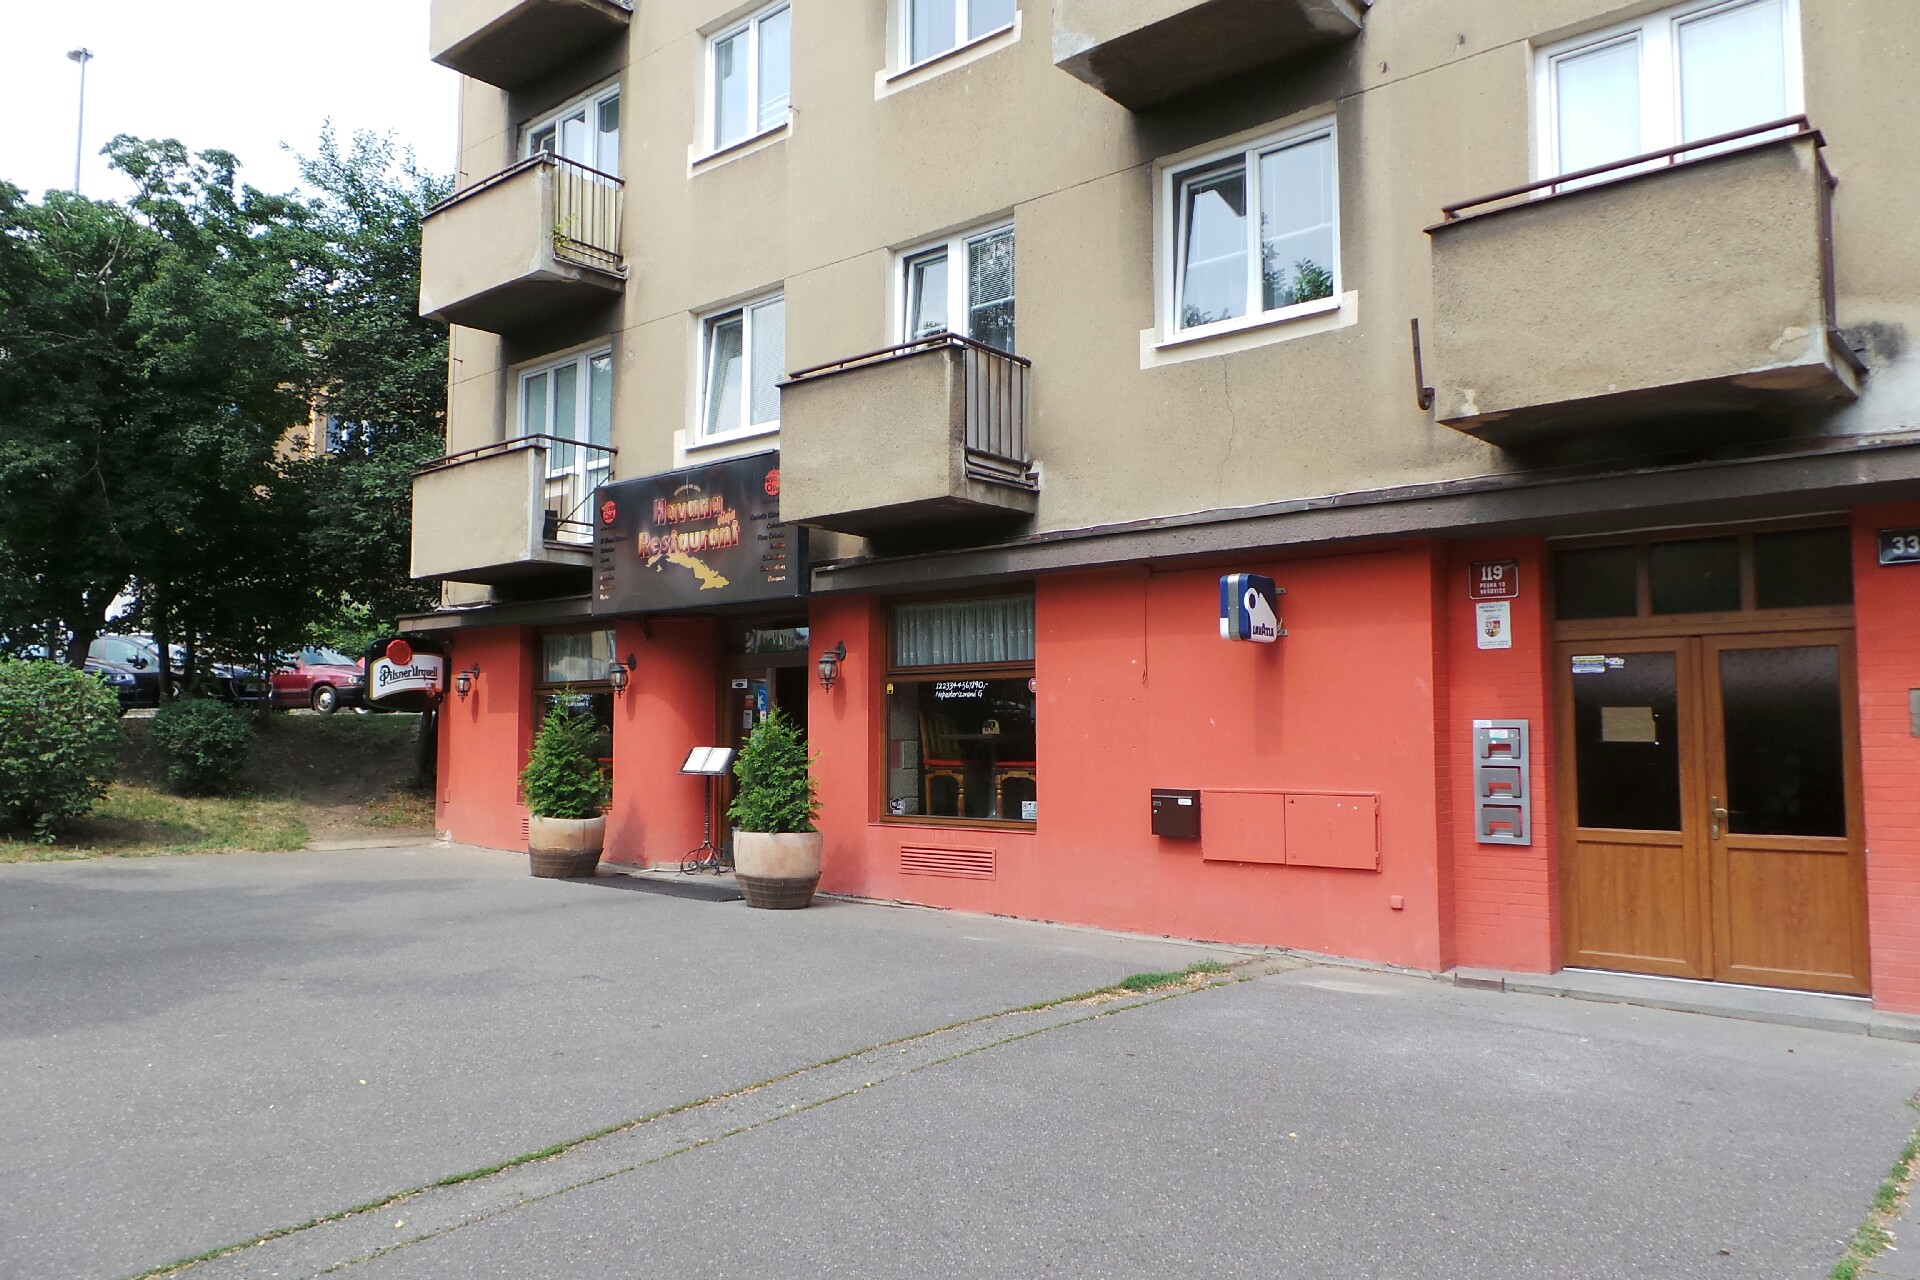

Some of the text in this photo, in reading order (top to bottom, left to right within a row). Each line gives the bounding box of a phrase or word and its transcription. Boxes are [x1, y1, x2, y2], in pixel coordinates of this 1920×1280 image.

[653, 496, 723, 526] Havana
[638, 520, 740, 559] Restaurant
[1481, 565, 1503, 581] 119
[379, 665, 438, 687] Pilsner Urquell
